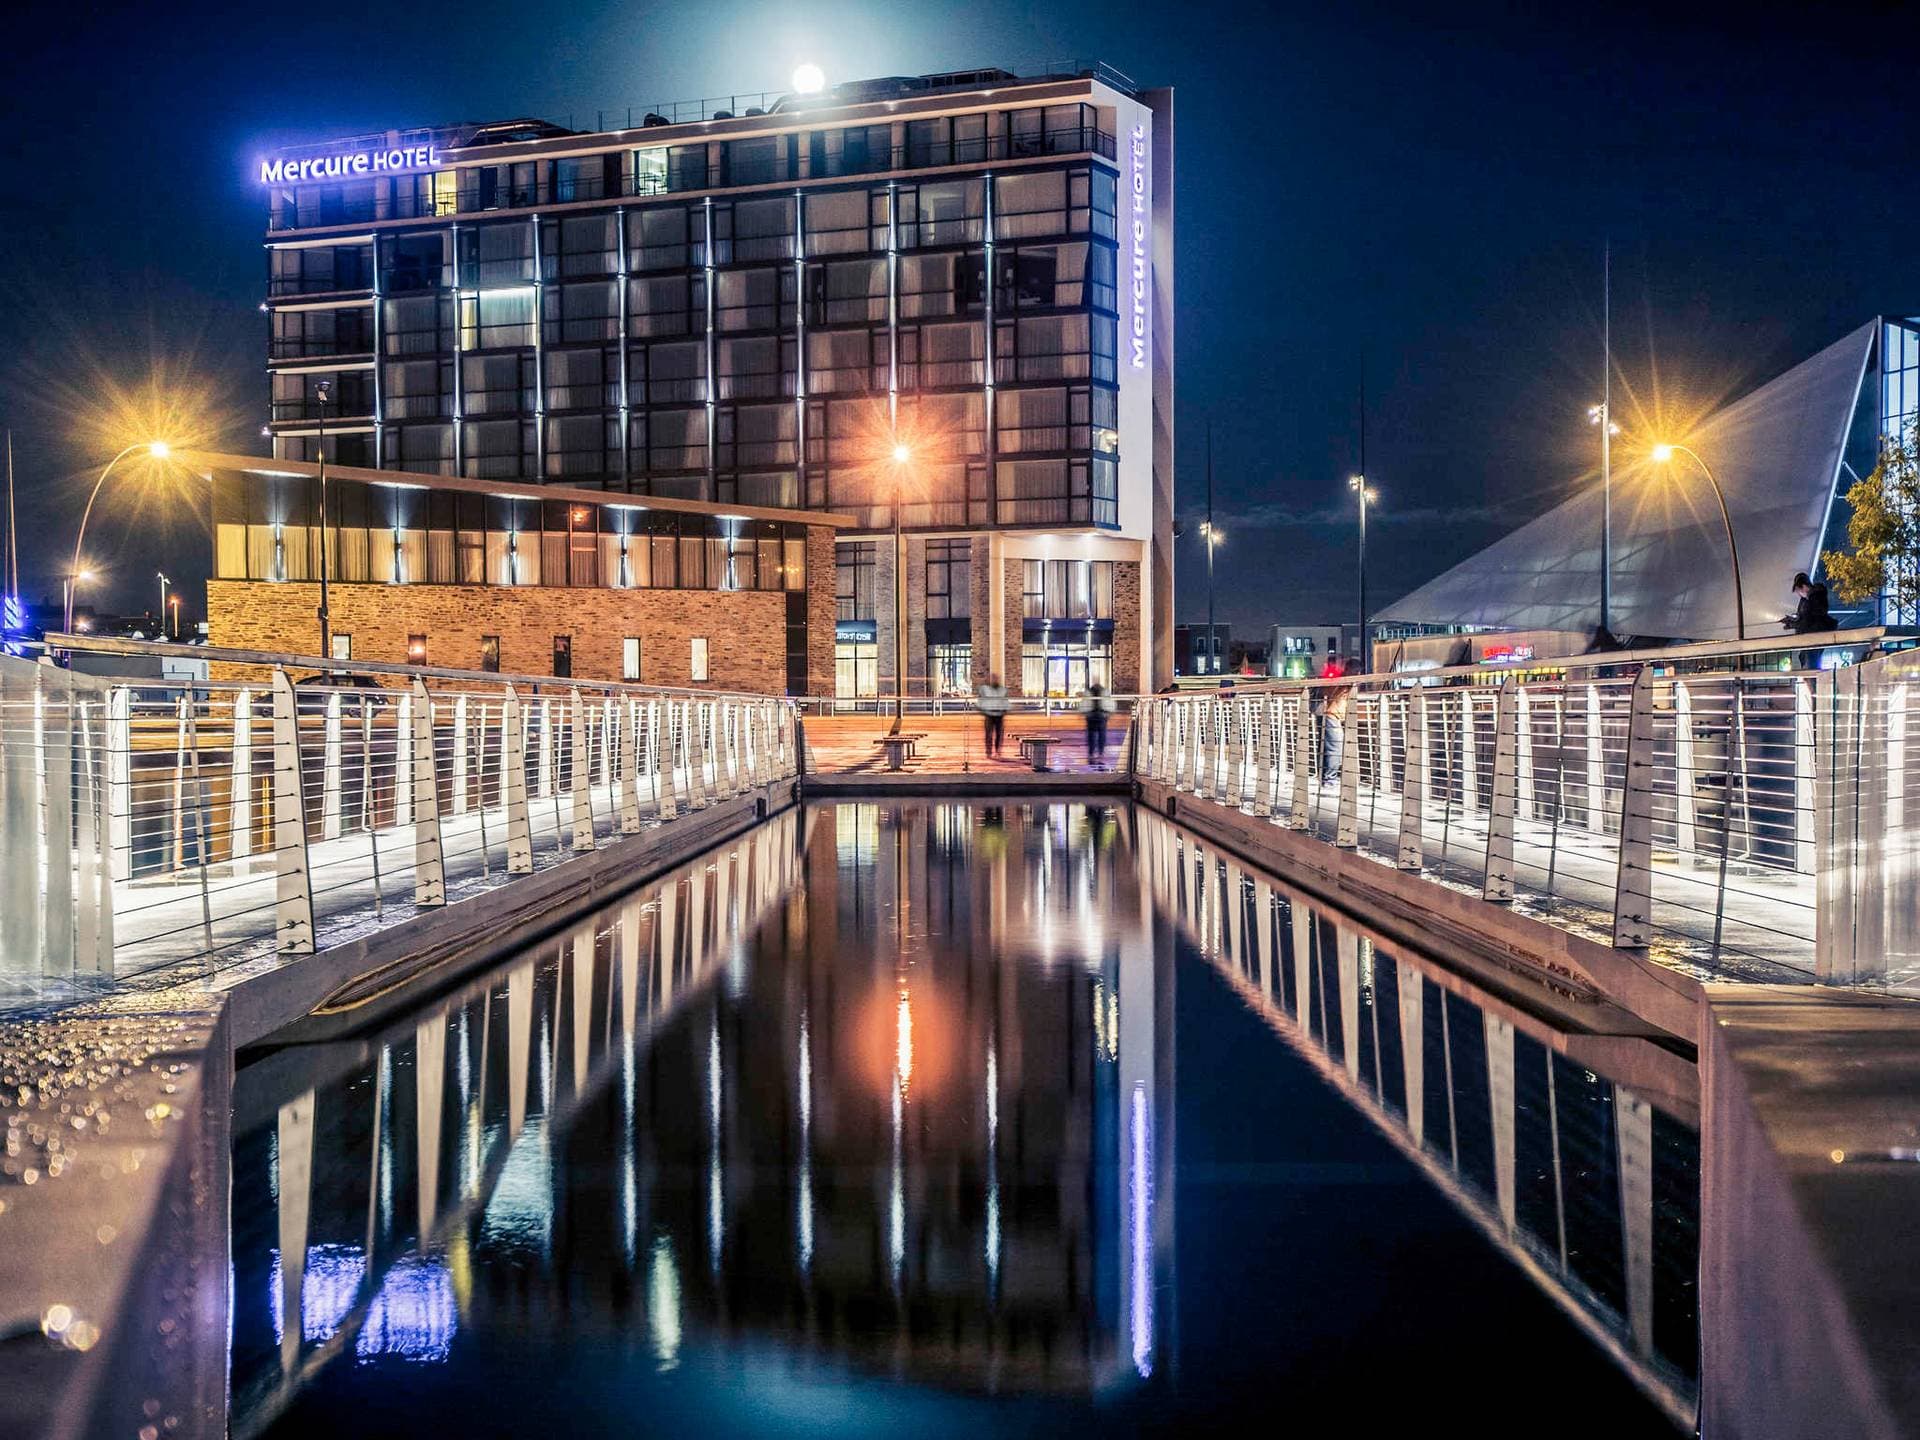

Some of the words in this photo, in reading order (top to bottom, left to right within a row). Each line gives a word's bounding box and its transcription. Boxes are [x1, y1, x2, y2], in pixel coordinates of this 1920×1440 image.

[261, 154, 368, 182] Mercure
[374, 147, 440, 171] HOTEL
[1131, 125, 1145, 211] HOTEL
[1131, 220, 1145, 368] Mercure
